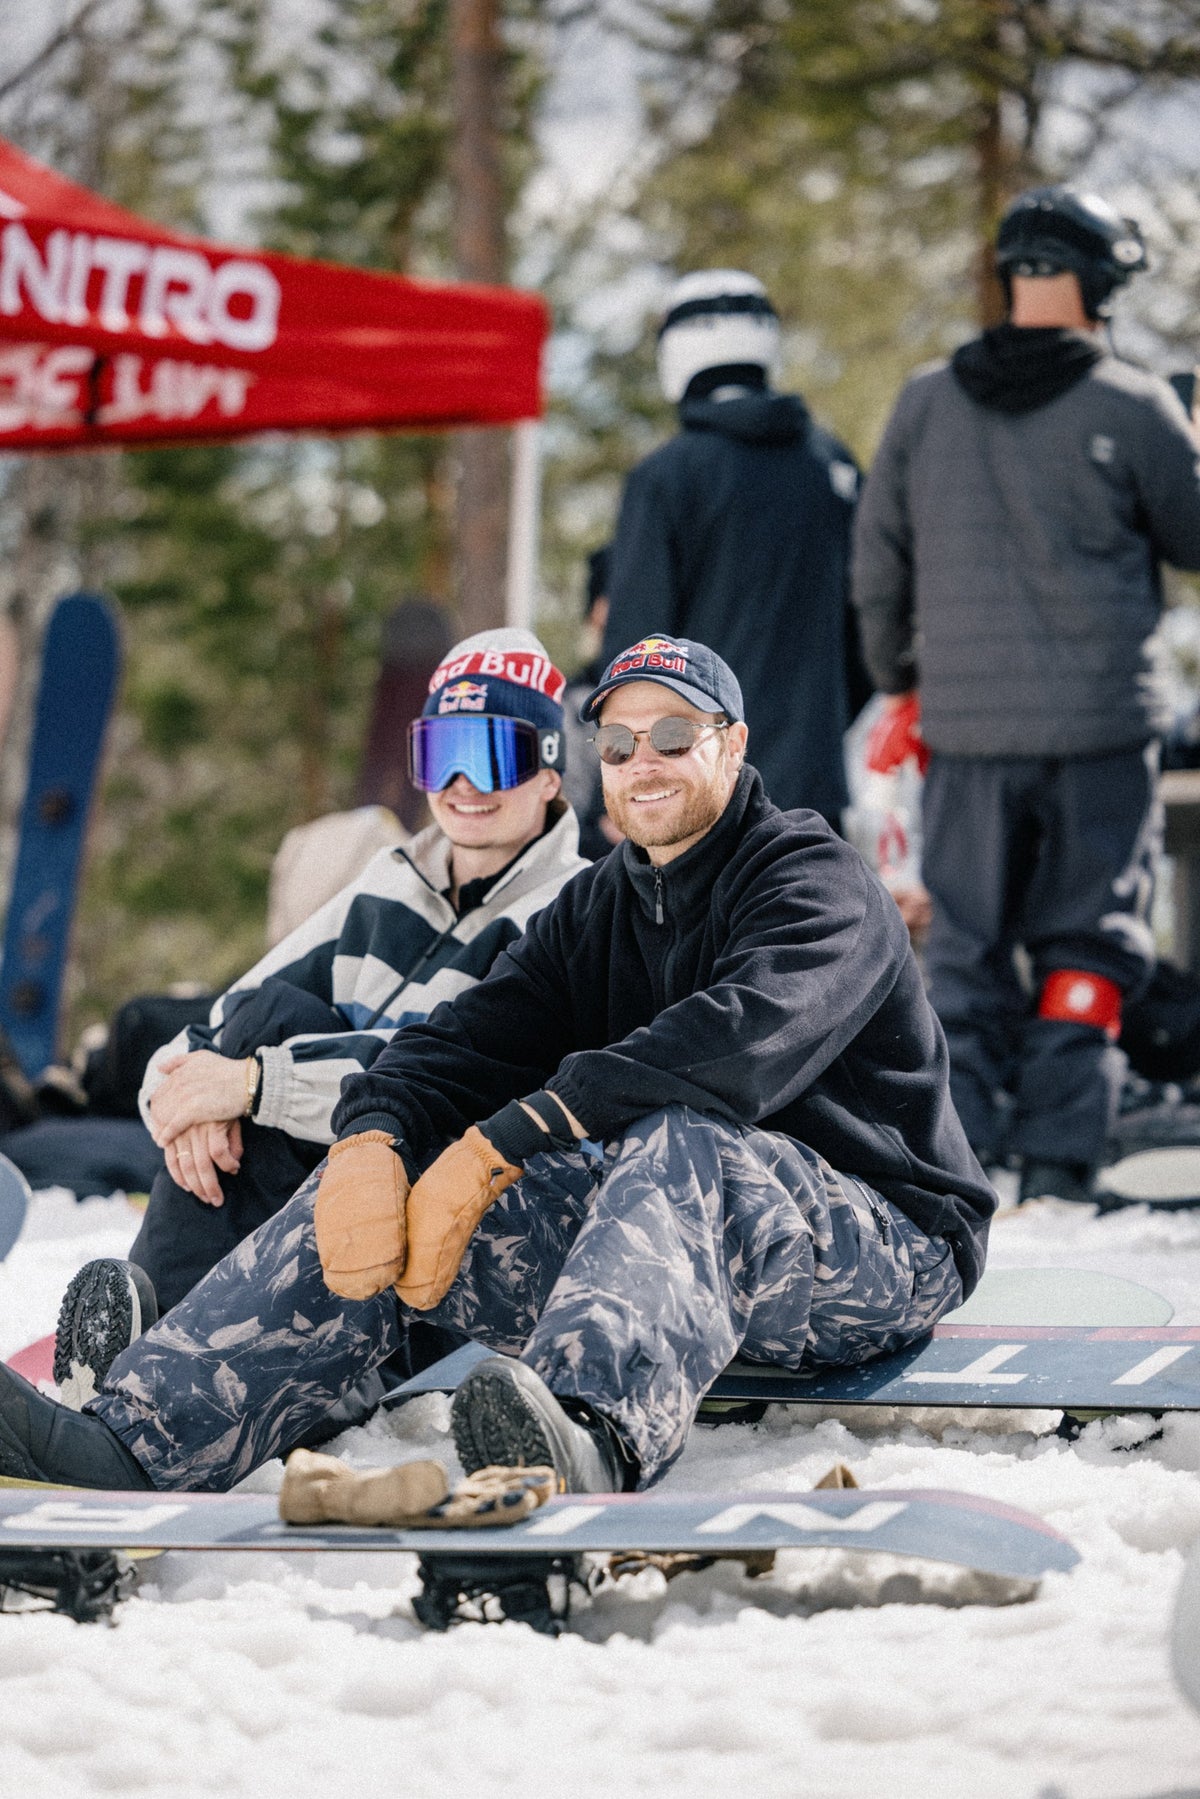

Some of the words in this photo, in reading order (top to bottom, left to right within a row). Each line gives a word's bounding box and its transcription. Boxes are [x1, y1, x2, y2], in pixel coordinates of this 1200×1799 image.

[1, 222, 281, 351] NITRO
[479, 651, 551, 693] Bull
[610, 654, 645, 678] Red
[647, 653, 687, 674] Bull
